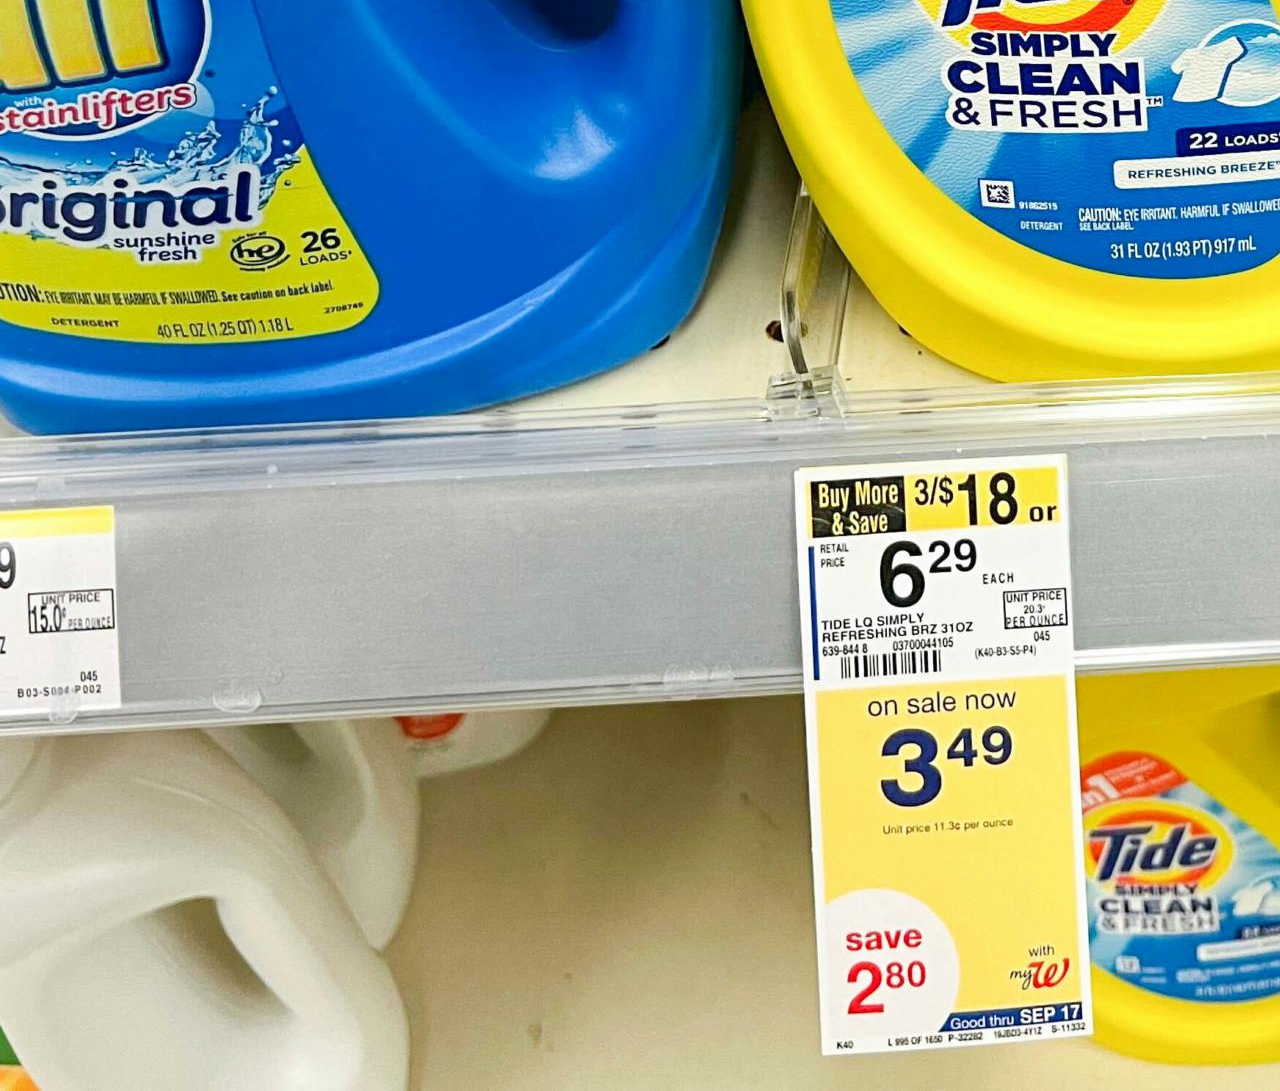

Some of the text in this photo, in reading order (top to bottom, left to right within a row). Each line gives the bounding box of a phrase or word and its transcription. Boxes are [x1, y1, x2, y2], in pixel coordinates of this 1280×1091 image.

[970, 31, 1117, 58] SIMPLY
[947, 60, 1141, 96] CLEAN
[14, 95, 42, 108] with
[952, 97, 980, 126] &
[1189, 132, 1218, 150] 22
[1128, 164, 1216, 179] REFRESHING
[0, 171, 253, 241] riginal
[1079, 208, 1121, 223] CAUTION:
[1124, 209, 1139, 222] EYE
[1141, 207, 1177, 221] IRRITANT.
[1180, 205, 1220, 219] HARMFUL
[1222, 204, 1230, 216] IF
[1020, 221, 1063, 231] DETERGENT
[1079, 222, 1092, 231] SEE
[1093, 222, 1111, 231] BACK
[114, 231, 215, 248] sunshine
[301, 228, 341, 254] 26
[1111, 235, 1257, 260] 31 FL OZ (1.93 PT) 917 mL
[137, 246, 197, 262] fresh
[0, 283, 310, 305] TION: EYE MAY BE HARMFUL IF SWALLOWED. See caution on back
[52, 318, 120, 328] DETERGENT
[157, 317, 294, 338] 40 FL OZ (1.25 QT) 1.18 L
[818, 479, 899, 512] Buy More
[1029, 504, 1057, 522] or
[831, 511, 888, 535] & Save
[820, 543, 849, 554] RETAIL
[821, 558, 845, 568] PRICE
[982, 572, 1015, 585] EACH
[41, 592, 101, 606] UNIT PRICE
[1006, 590, 1062, 603] UNIT PRICE
[68, 616, 112, 629] PER OUNCE
[821, 613, 924, 631] TIDE LQ SIMPLY
[1006, 614, 1064, 627] PER OUNCE
[822, 622, 973, 642] REFRESHING BRZ 31OZ
[1034, 630, 1050, 641] 045
[822, 637, 953, 656] 639-844 03700044105
[80, 671, 98, 682] 045
[867, 690, 1016, 717] on sale now
[882, 818, 1013, 836] Unit price per ounce
[1089, 824, 1217, 881] Tide
[1100, 897, 1212, 915] CLEAN
[846, 929, 922, 951] save
[1029, 943, 1055, 957] with
[950, 1005, 1080, 1029] Good thru SEP 17
[837, 1036, 922, 1050] K40 OF
